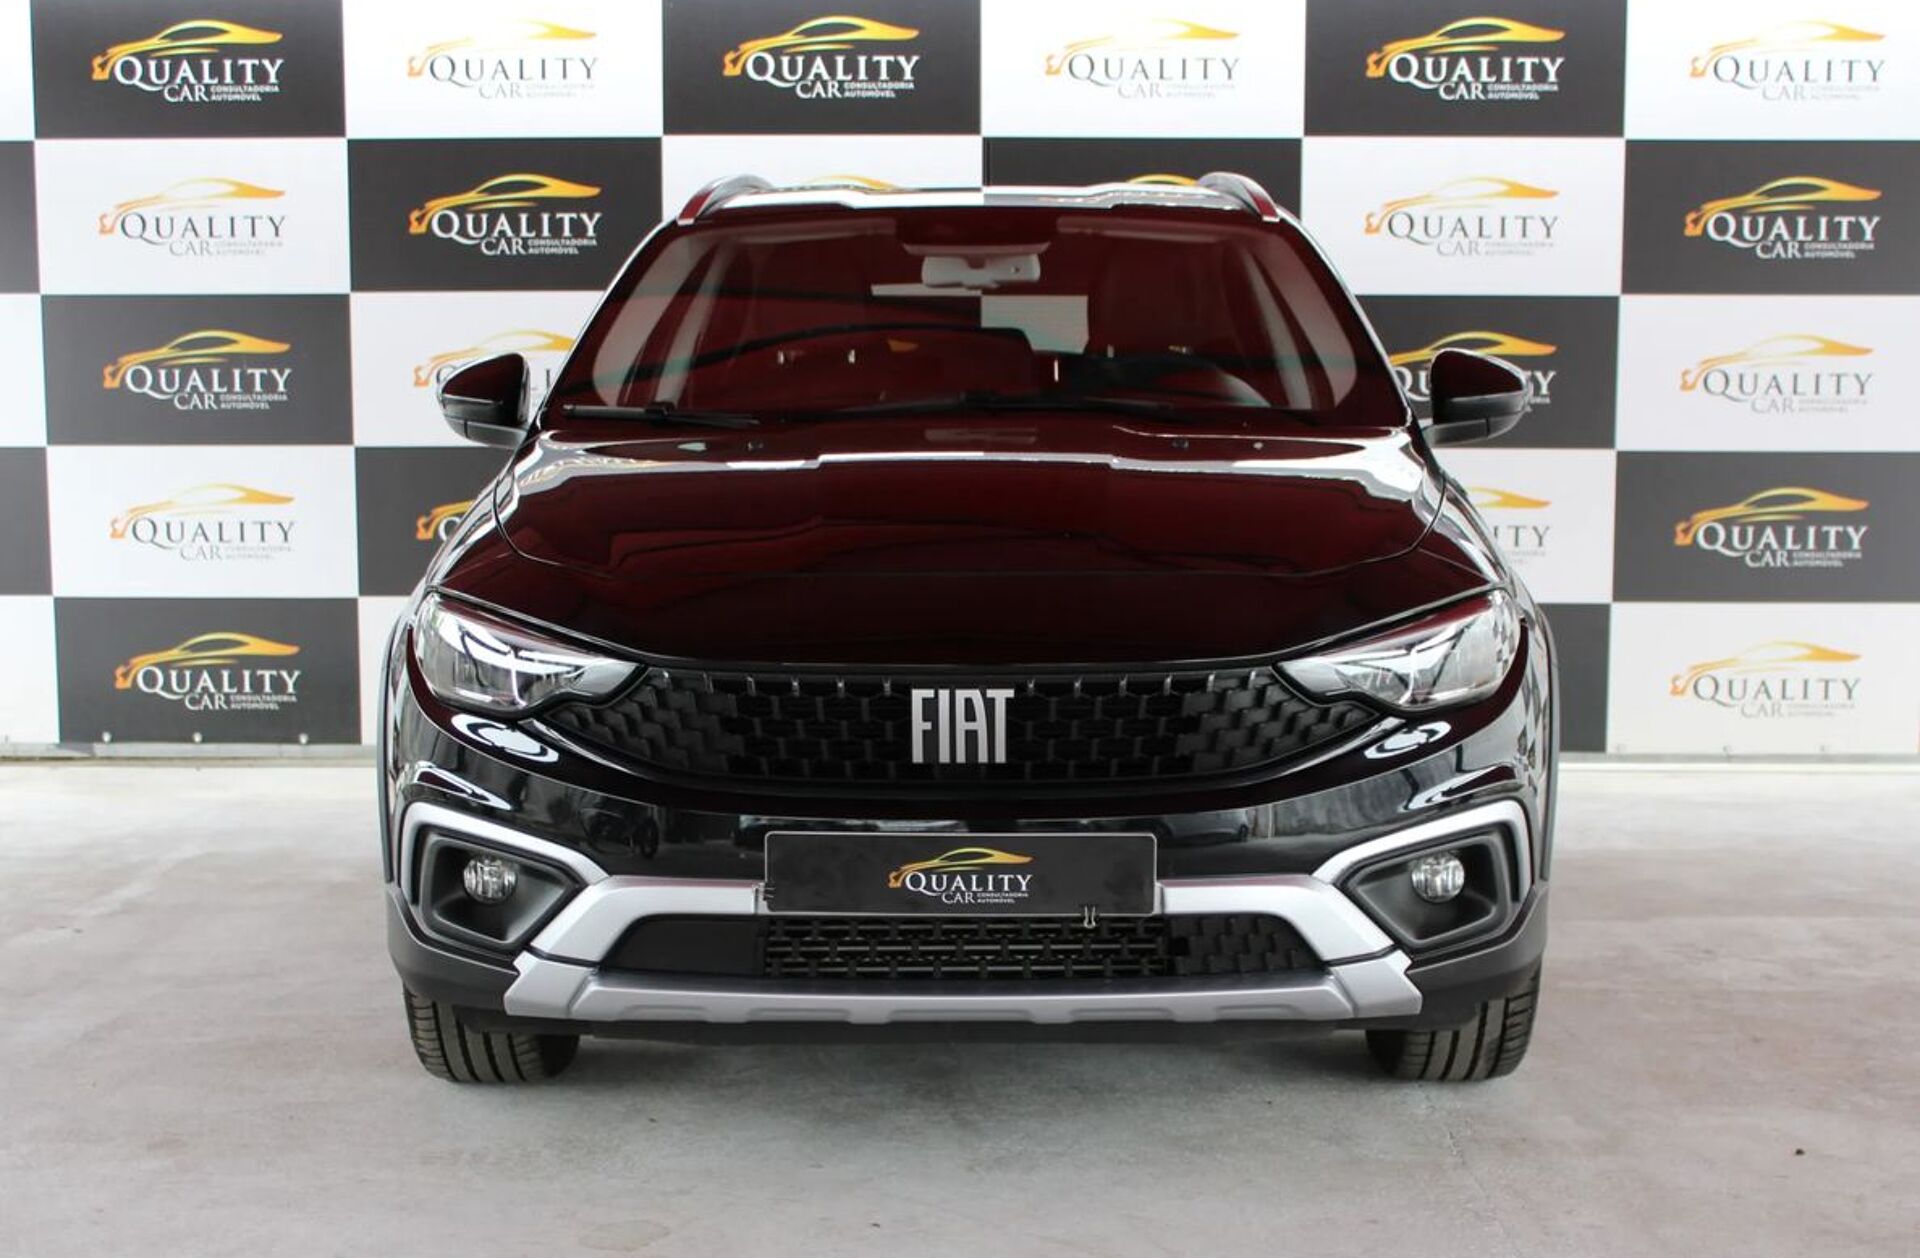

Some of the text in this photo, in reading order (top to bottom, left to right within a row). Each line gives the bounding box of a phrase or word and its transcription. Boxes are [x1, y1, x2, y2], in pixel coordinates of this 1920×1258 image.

[114, 56, 284, 91] QUALITY
[429, 55, 599, 88] QUALITY
[745, 52, 920, 87] QUALITY
[1067, 53, 1240, 87] QUALITY
[1389, 53, 1565, 89] QUALITY
[1712, 55, 1886, 90] QUALITY
[164, 84, 209, 102] CAR
[478, 82, 524, 99] CAR
[795, 81, 843, 98] CAR
[1118, 82, 1163, 99] CAR
[1439, 82, 1487, 100] CAR
[1762, 84, 1807, 101] CAR
[120, 212, 287, 246] QUALITY
[431, 210, 601, 245] QUALITY
[1387, 213, 1559, 248] QUALITY
[1706, 212, 1880, 248] QUALITY
[169, 240, 215, 257] CAR
[481, 238, 526, 256] CAR
[1436, 241, 1482, 258] CAR
[1756, 241, 1802, 259] CAR
[125, 365, 292, 399] QUALITY
[1702, 369, 1874, 403] QUALITY
[173, 393, 219, 410] CAR
[1751, 397, 1796, 414] CAR
[131, 517, 296, 550] QUALITY
[1696, 522, 1868, 557] QUALITY
[179, 544, 223, 561] CAR
[1745, 550, 1791, 568] CAR
[136, 666, 301, 700] QUALITY
[1692, 674, 1862, 708] QUALITY
[184, 693, 229, 710] CAR
[1741, 702, 1785, 719] CAR
[911, 688, 1015, 764] FIAT
[905, 871, 1032, 897] QUALITY
[942, 892, 976, 904] CAR
